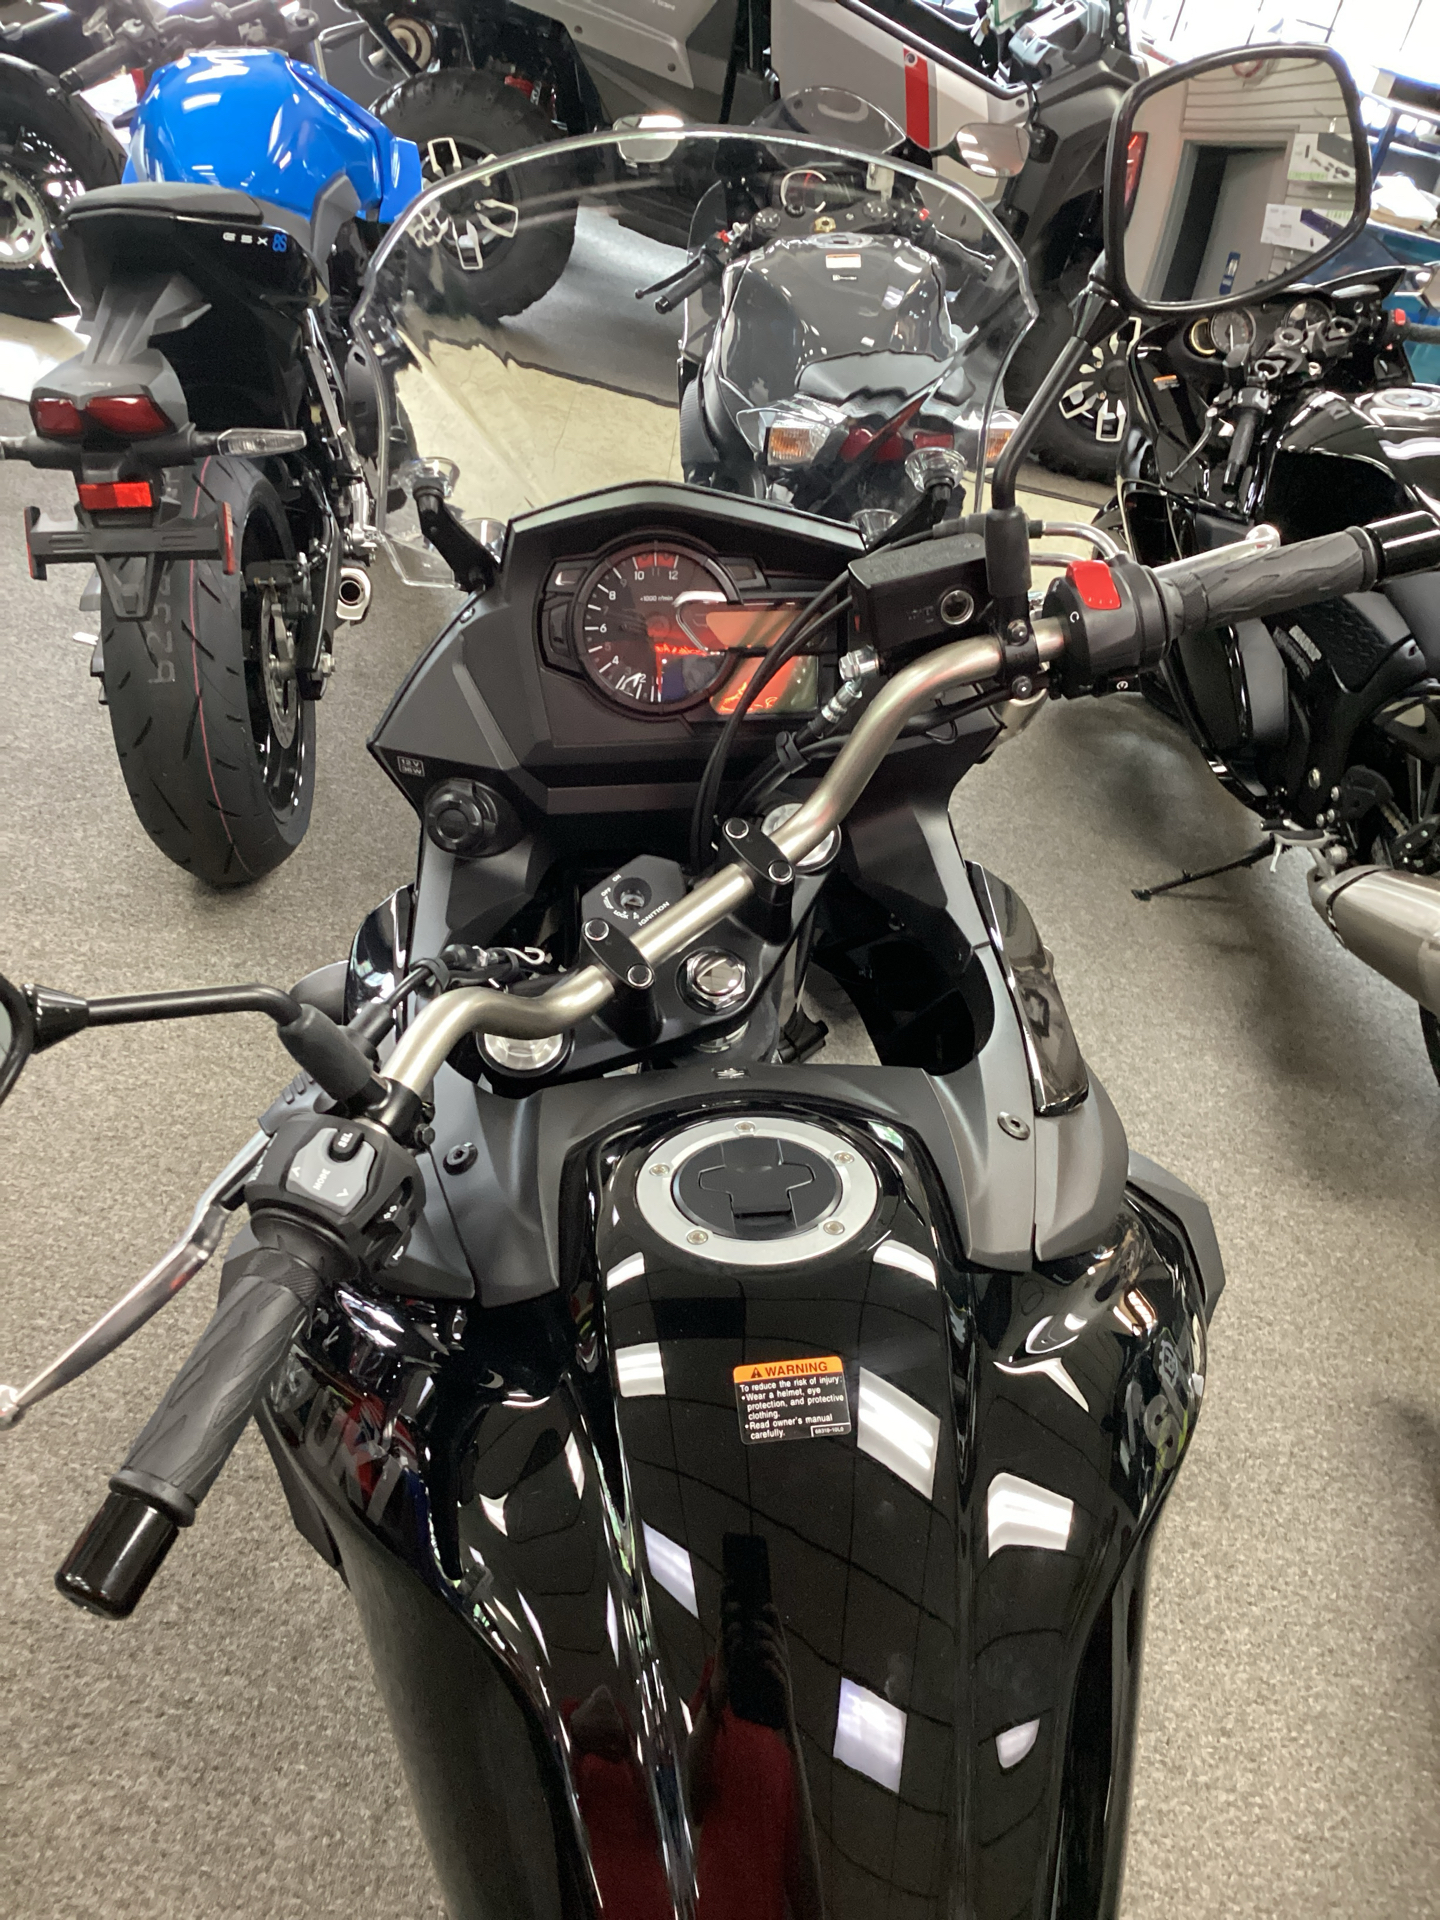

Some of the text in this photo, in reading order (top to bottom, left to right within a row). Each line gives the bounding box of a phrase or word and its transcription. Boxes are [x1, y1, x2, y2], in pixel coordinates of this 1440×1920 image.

[634, 570, 645, 580] 10
[668, 570, 679, 580] 12
[608, 590, 616, 600] 8
[599, 623, 607, 633] 6
[612, 655, 619, 665] 4
[639, 673, 646, 683] 2
[612, 874, 622, 882] ON
[601, 887, 611, 896] OFF
[613, 910, 629, 919] LOCK
[638, 901, 670, 926] IGNITION
[338, 1132, 353, 1148] SEL
[312, 1168, 331, 1191] MODE
[765, 1361, 828, 1377] WARNING
[740, 1384, 749, 1393] To
[751, 1381, 777, 1391] reduce
[779, 1379, 791, 1388] the
[793, 1377, 807, 1386] risk
[810, 1377, 817, 1385] of
[745, 1387, 821, 1402] Wear a helmet, eye
[747, 1394, 844, 1412] protection, and protective
[748, 1410, 780, 1421] clothing.
[749, 1413, 833, 1430] Read owner's manual
[750, 1429, 786, 1440] carefully.
